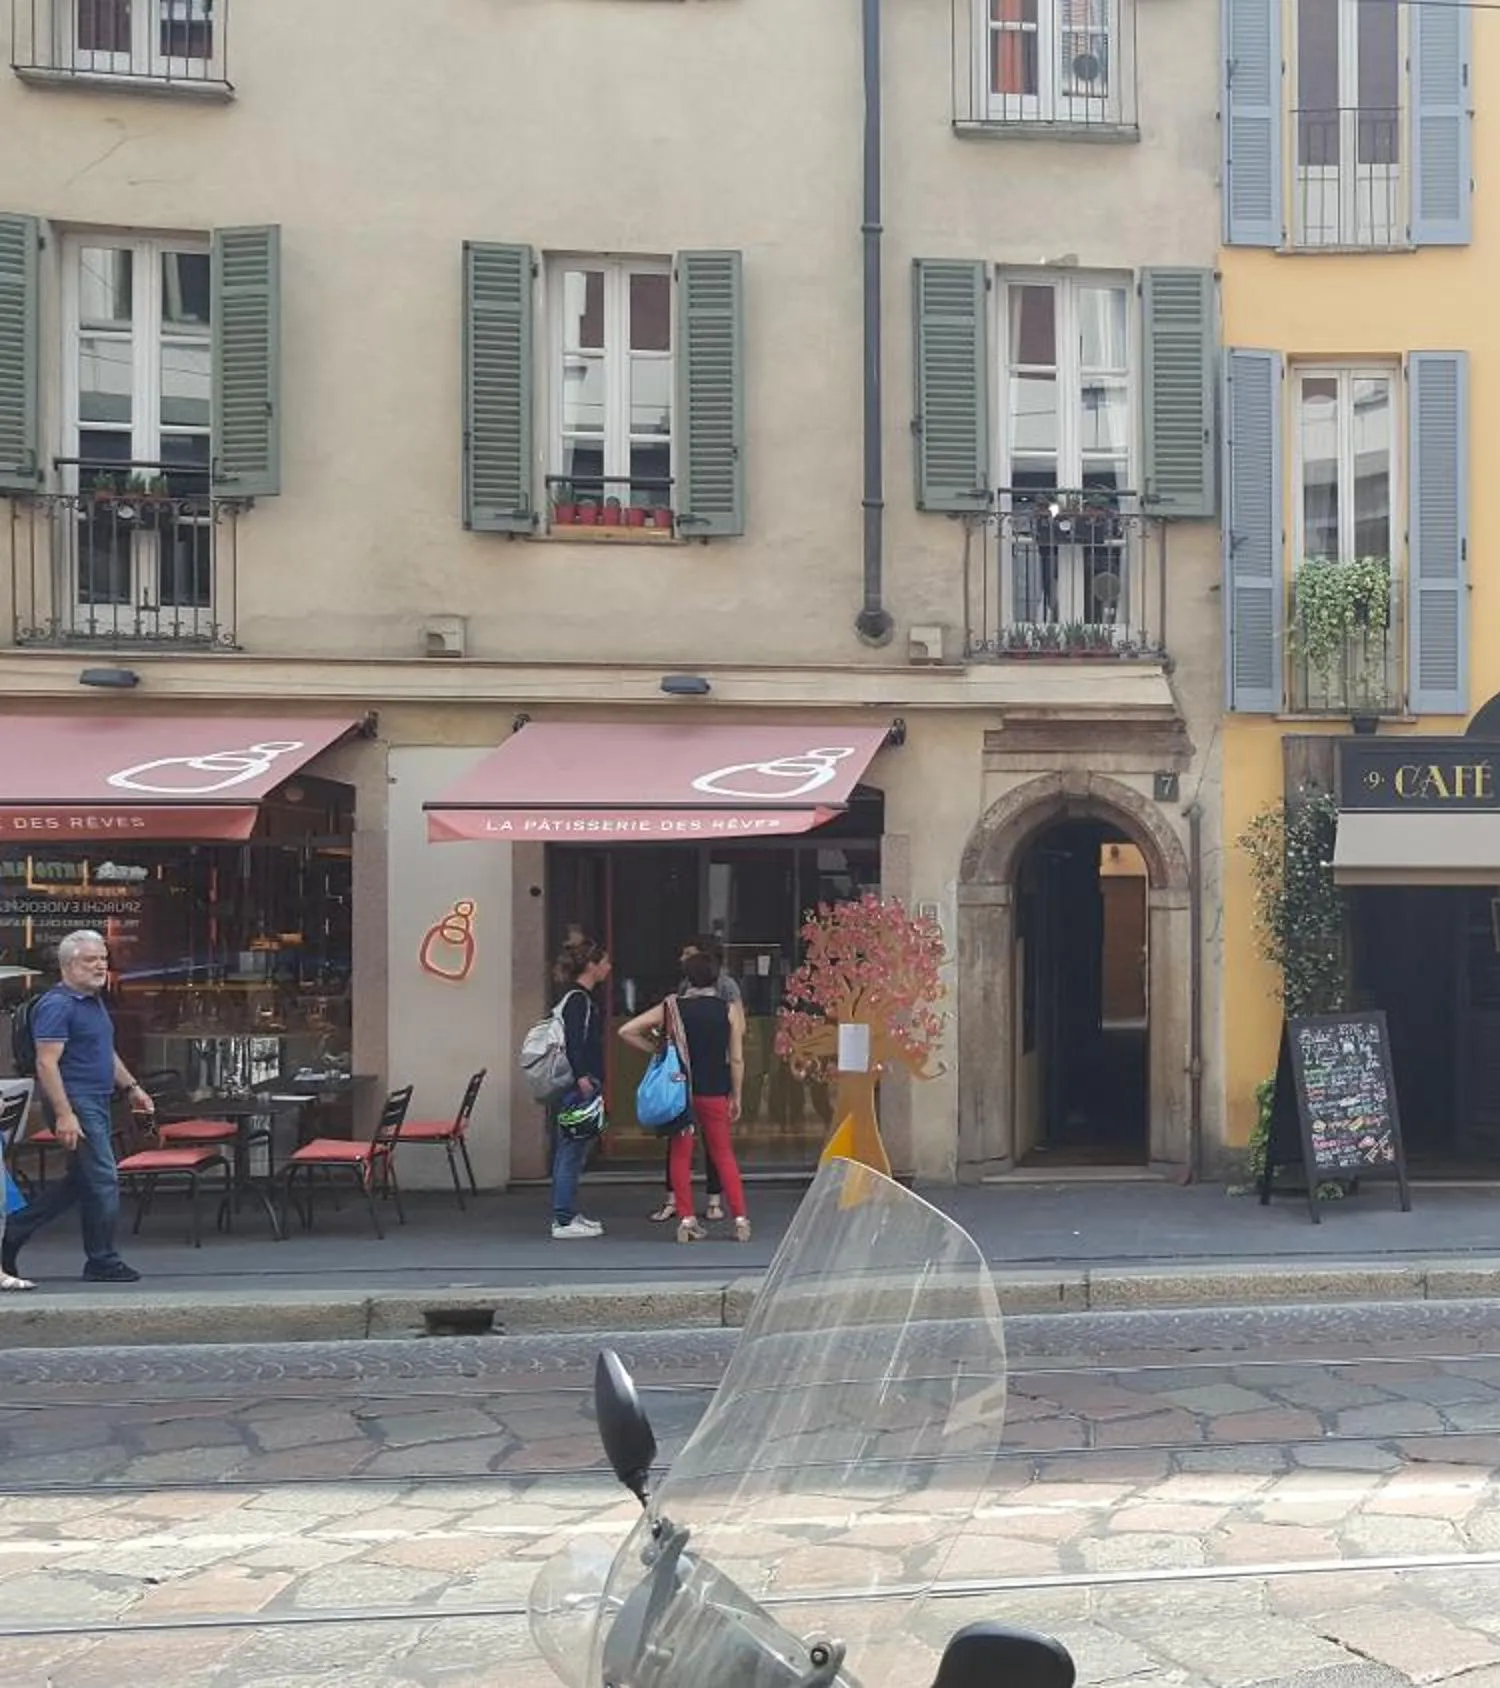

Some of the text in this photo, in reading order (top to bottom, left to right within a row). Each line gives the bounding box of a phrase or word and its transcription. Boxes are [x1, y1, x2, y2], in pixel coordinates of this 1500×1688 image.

[1161, 776, 1173, 796] 7
[1395, 760, 1493, 798] CAFÉ
[13, 817, 59, 829] DES
[486, 820, 513, 831] LA
[661, 819, 700, 831] DES
